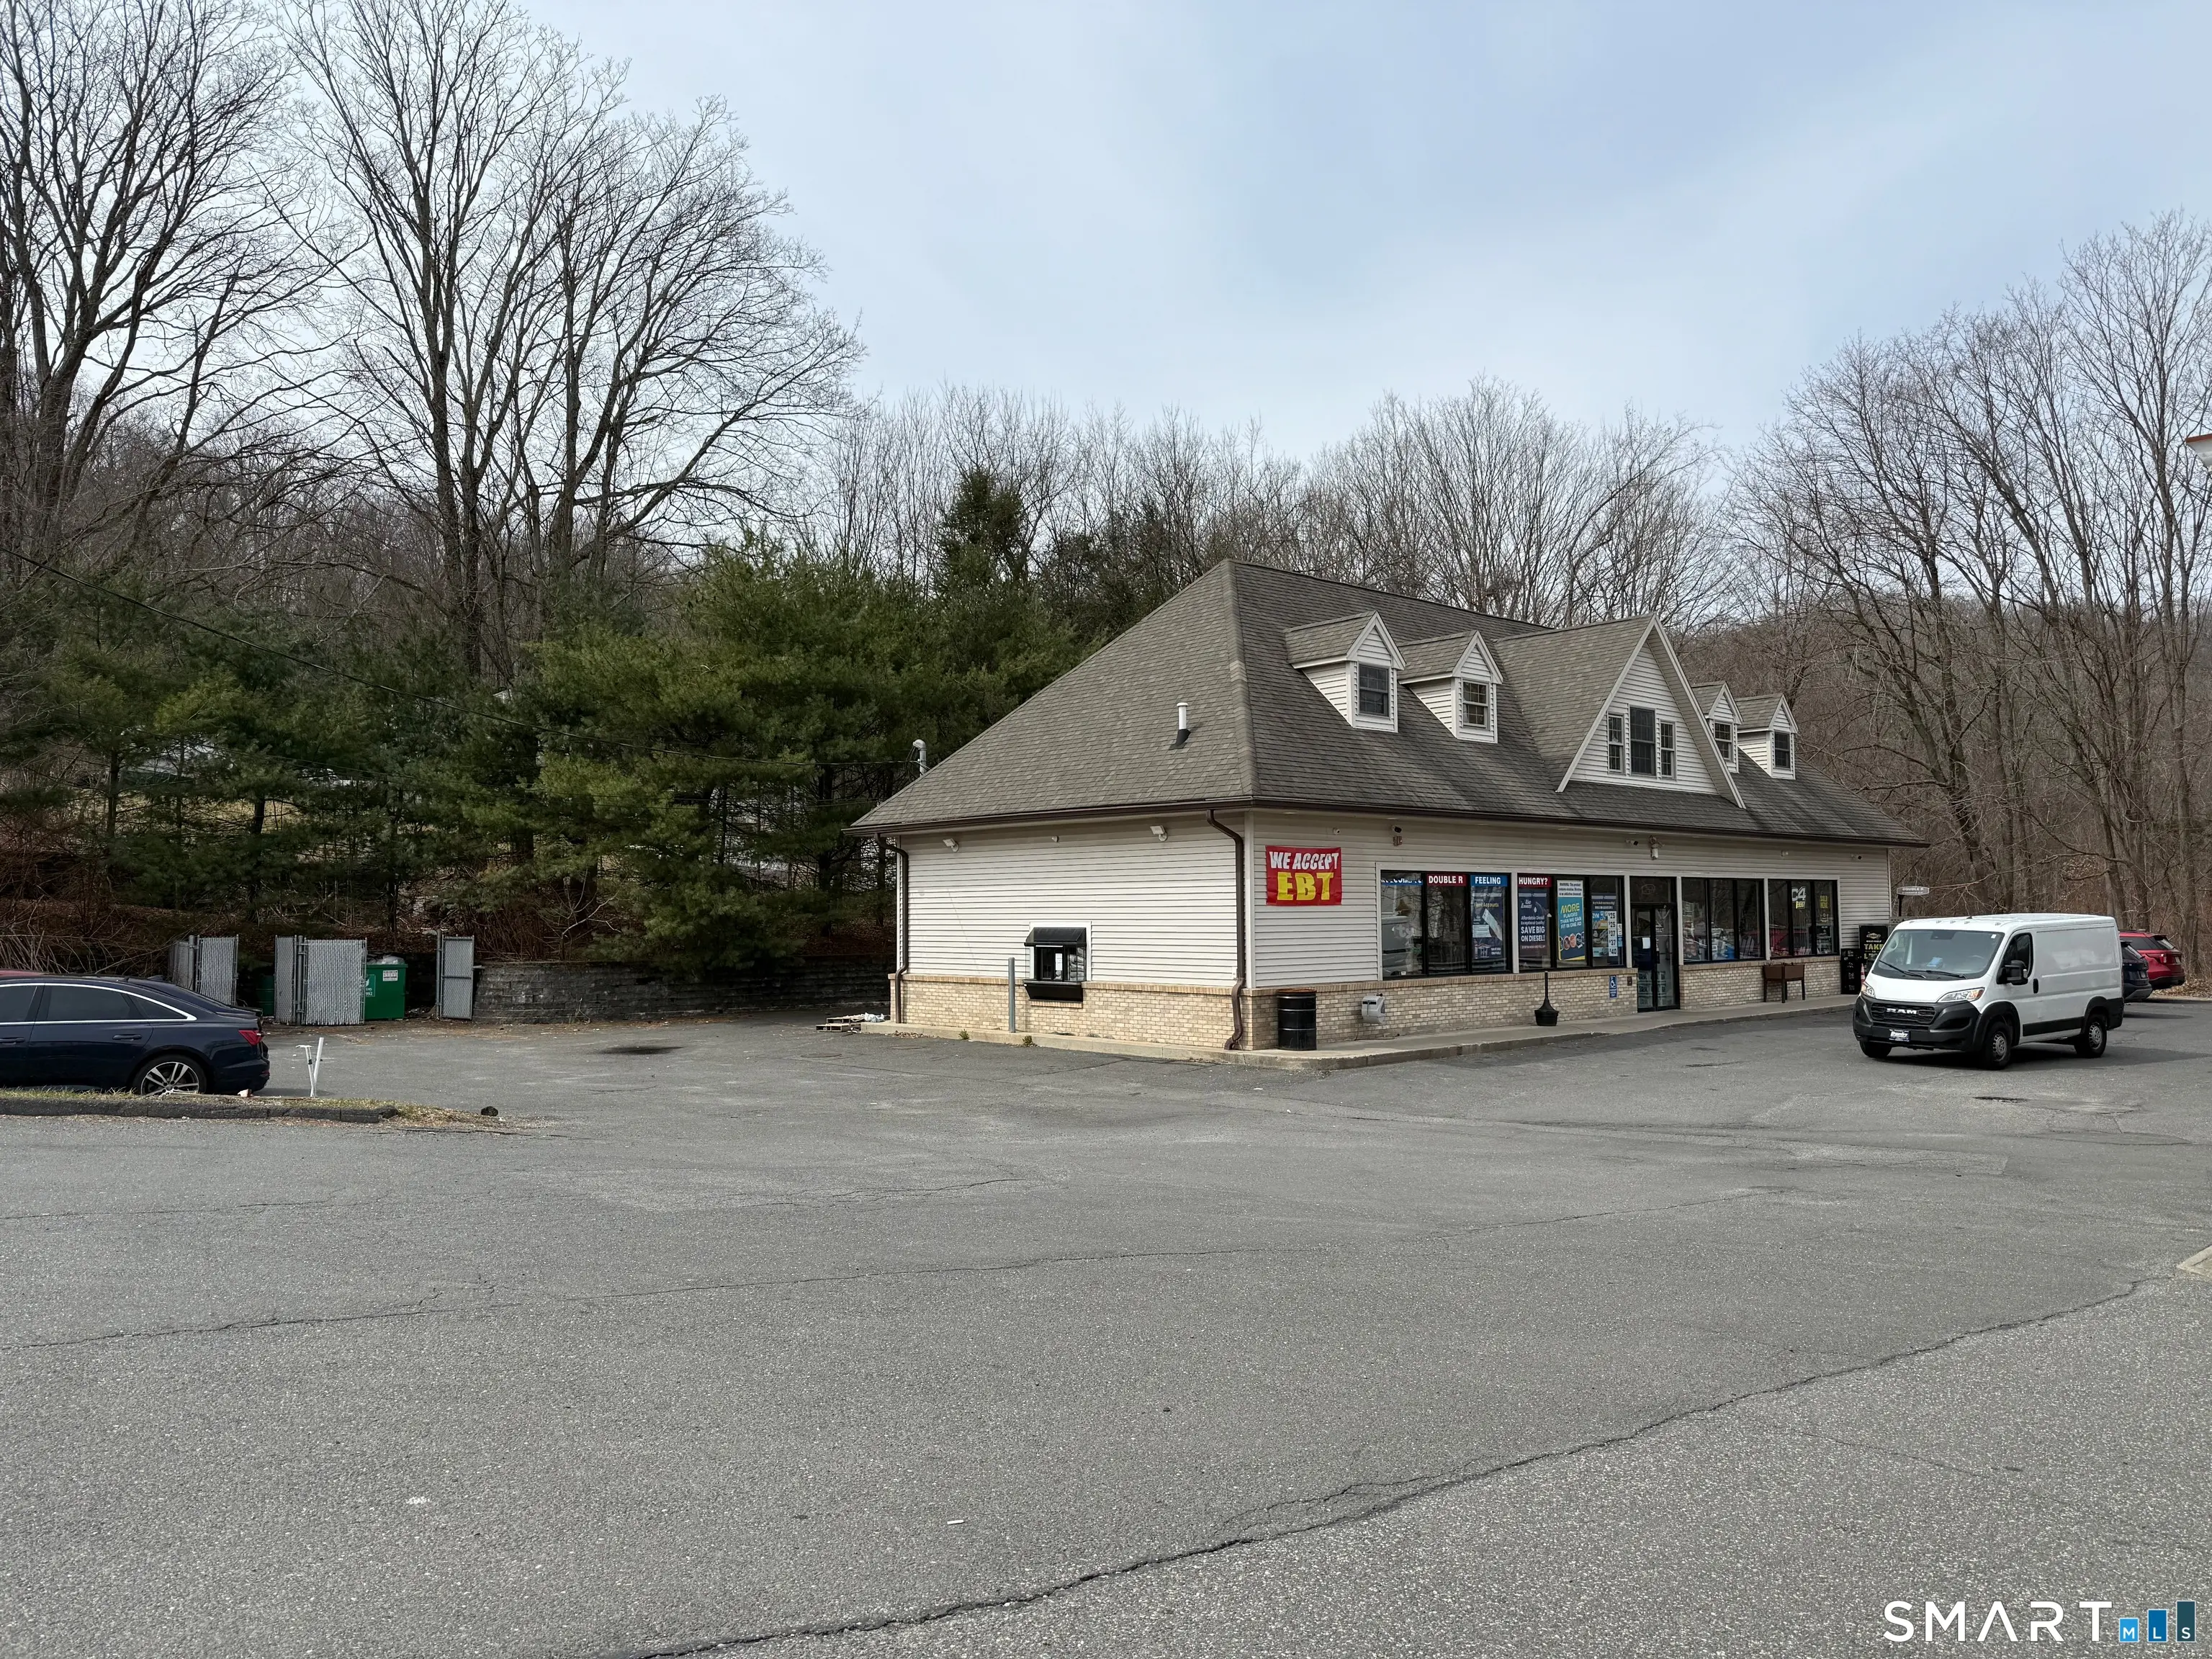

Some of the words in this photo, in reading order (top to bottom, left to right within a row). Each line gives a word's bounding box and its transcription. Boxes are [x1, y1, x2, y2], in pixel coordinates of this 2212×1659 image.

[1269, 851, 1292, 869] WE
[1292, 853, 1339, 870] ACCEPT
[1277, 871, 1334, 900] EBT
[1475, 876, 1501, 885] FEELING
[1791, 886, 1806, 901] C4
[1560, 903, 1580, 914] MORE
